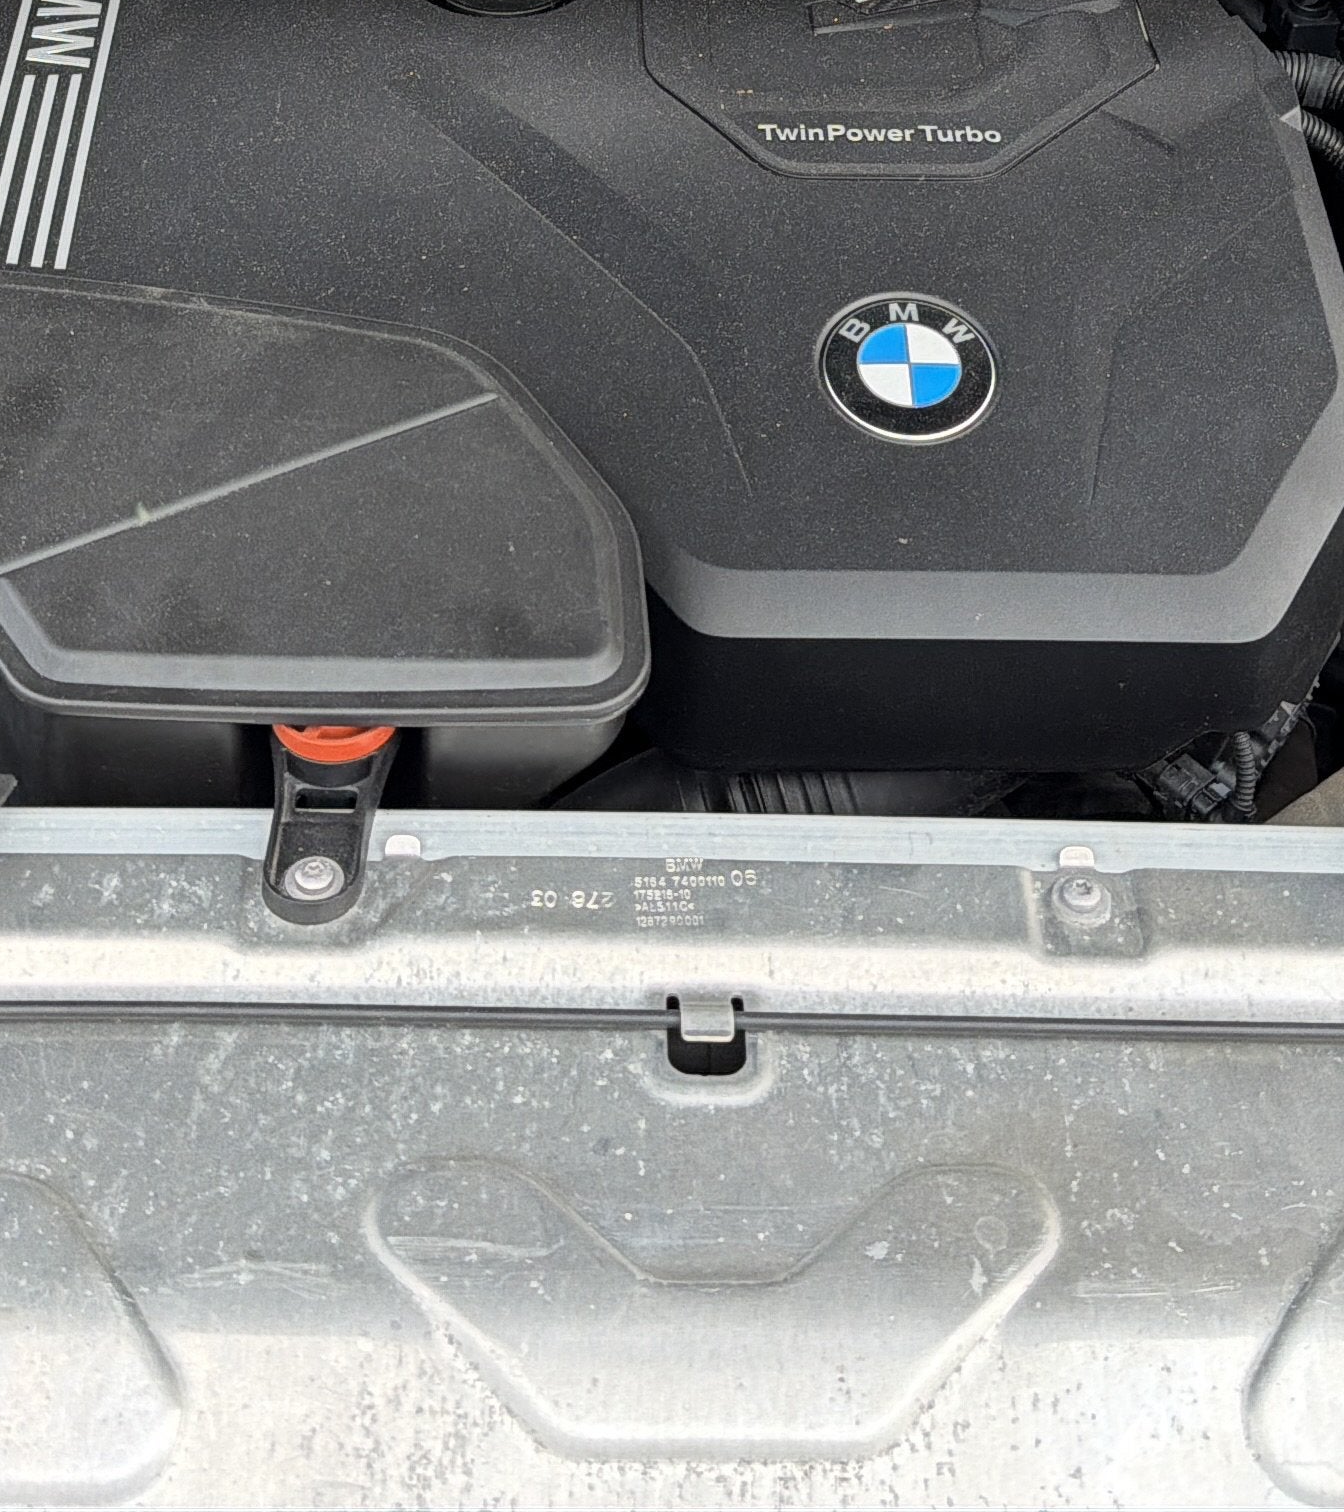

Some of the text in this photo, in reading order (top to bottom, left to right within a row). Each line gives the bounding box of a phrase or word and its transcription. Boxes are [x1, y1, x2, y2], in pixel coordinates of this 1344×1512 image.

[758, 123, 1002, 144] TwinPower Turbo
[838, 302, 976, 344] BMW
[665, 857, 704, 873] BMW
